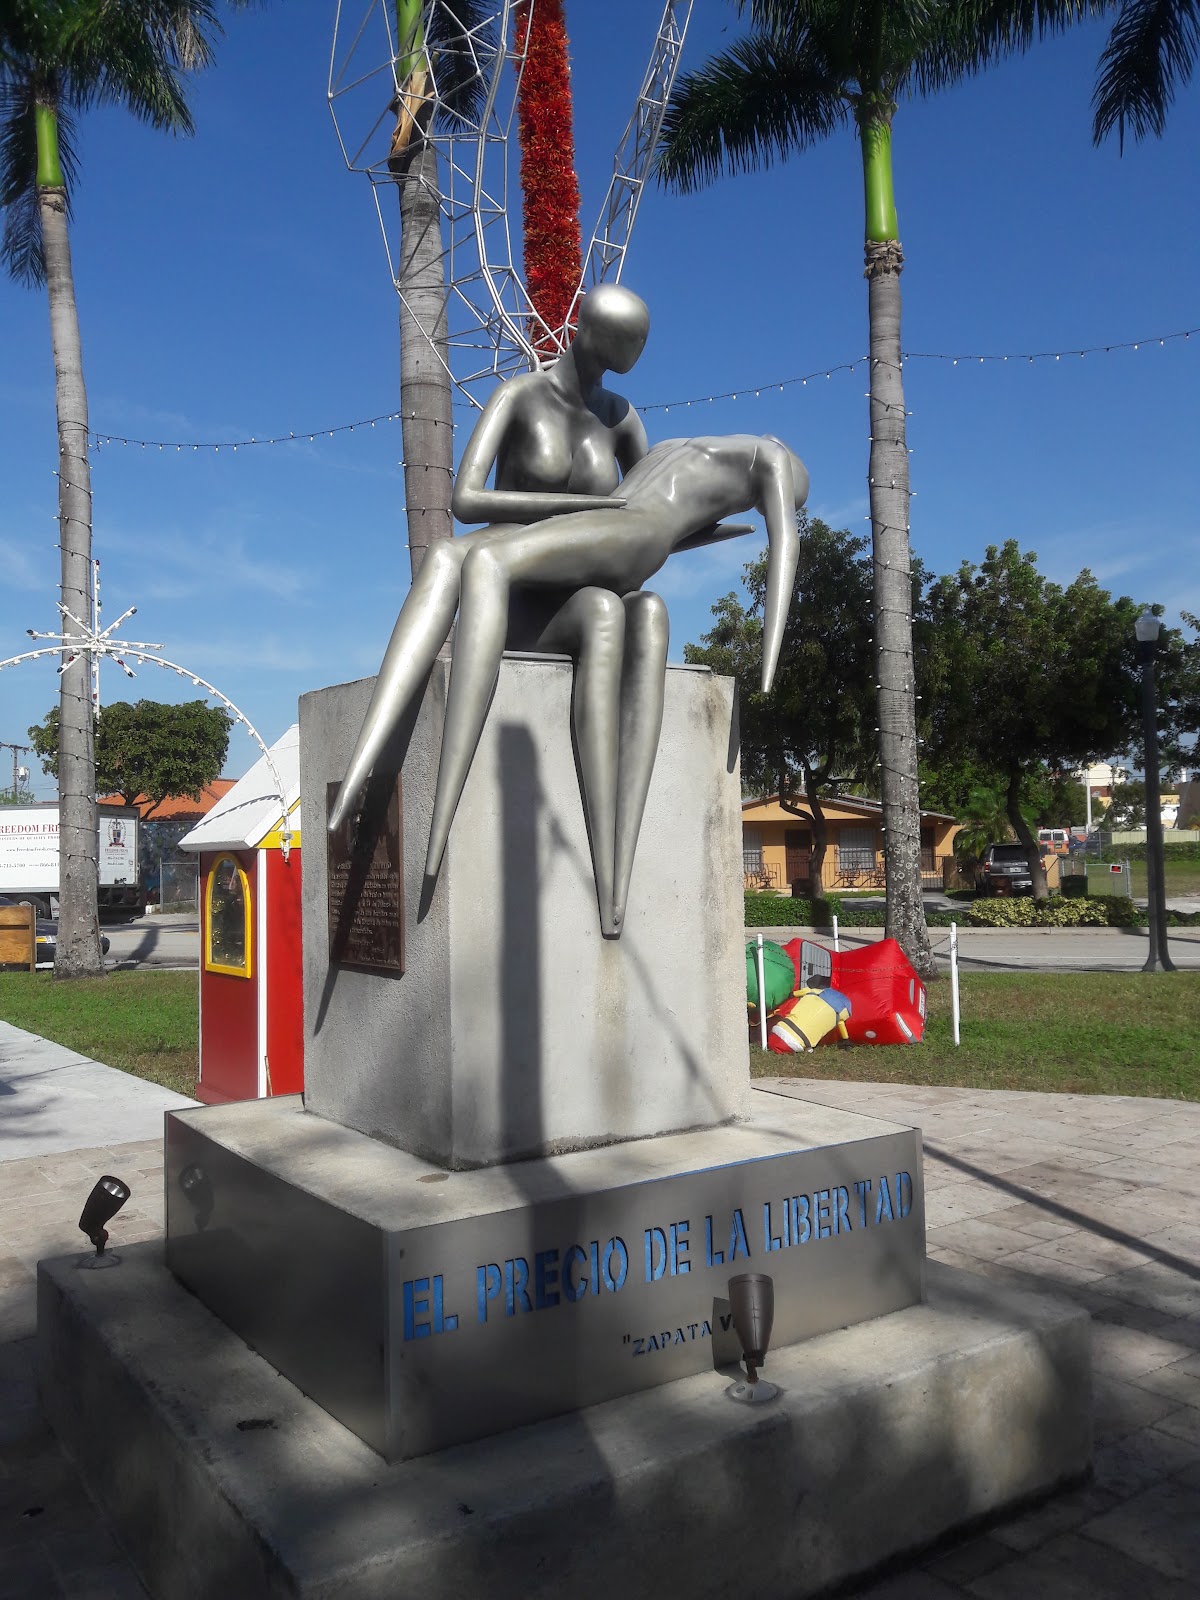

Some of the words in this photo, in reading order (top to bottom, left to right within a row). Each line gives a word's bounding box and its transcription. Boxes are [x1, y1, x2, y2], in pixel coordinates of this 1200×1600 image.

[403, 1274, 459, 1342] EL
[476, 1236, 630, 1325] PRECIO
[644, 1219, 692, 1283] DE
[704, 1208, 751, 1269] LA
[763, 1171, 913, 1253] LIBERTAD
